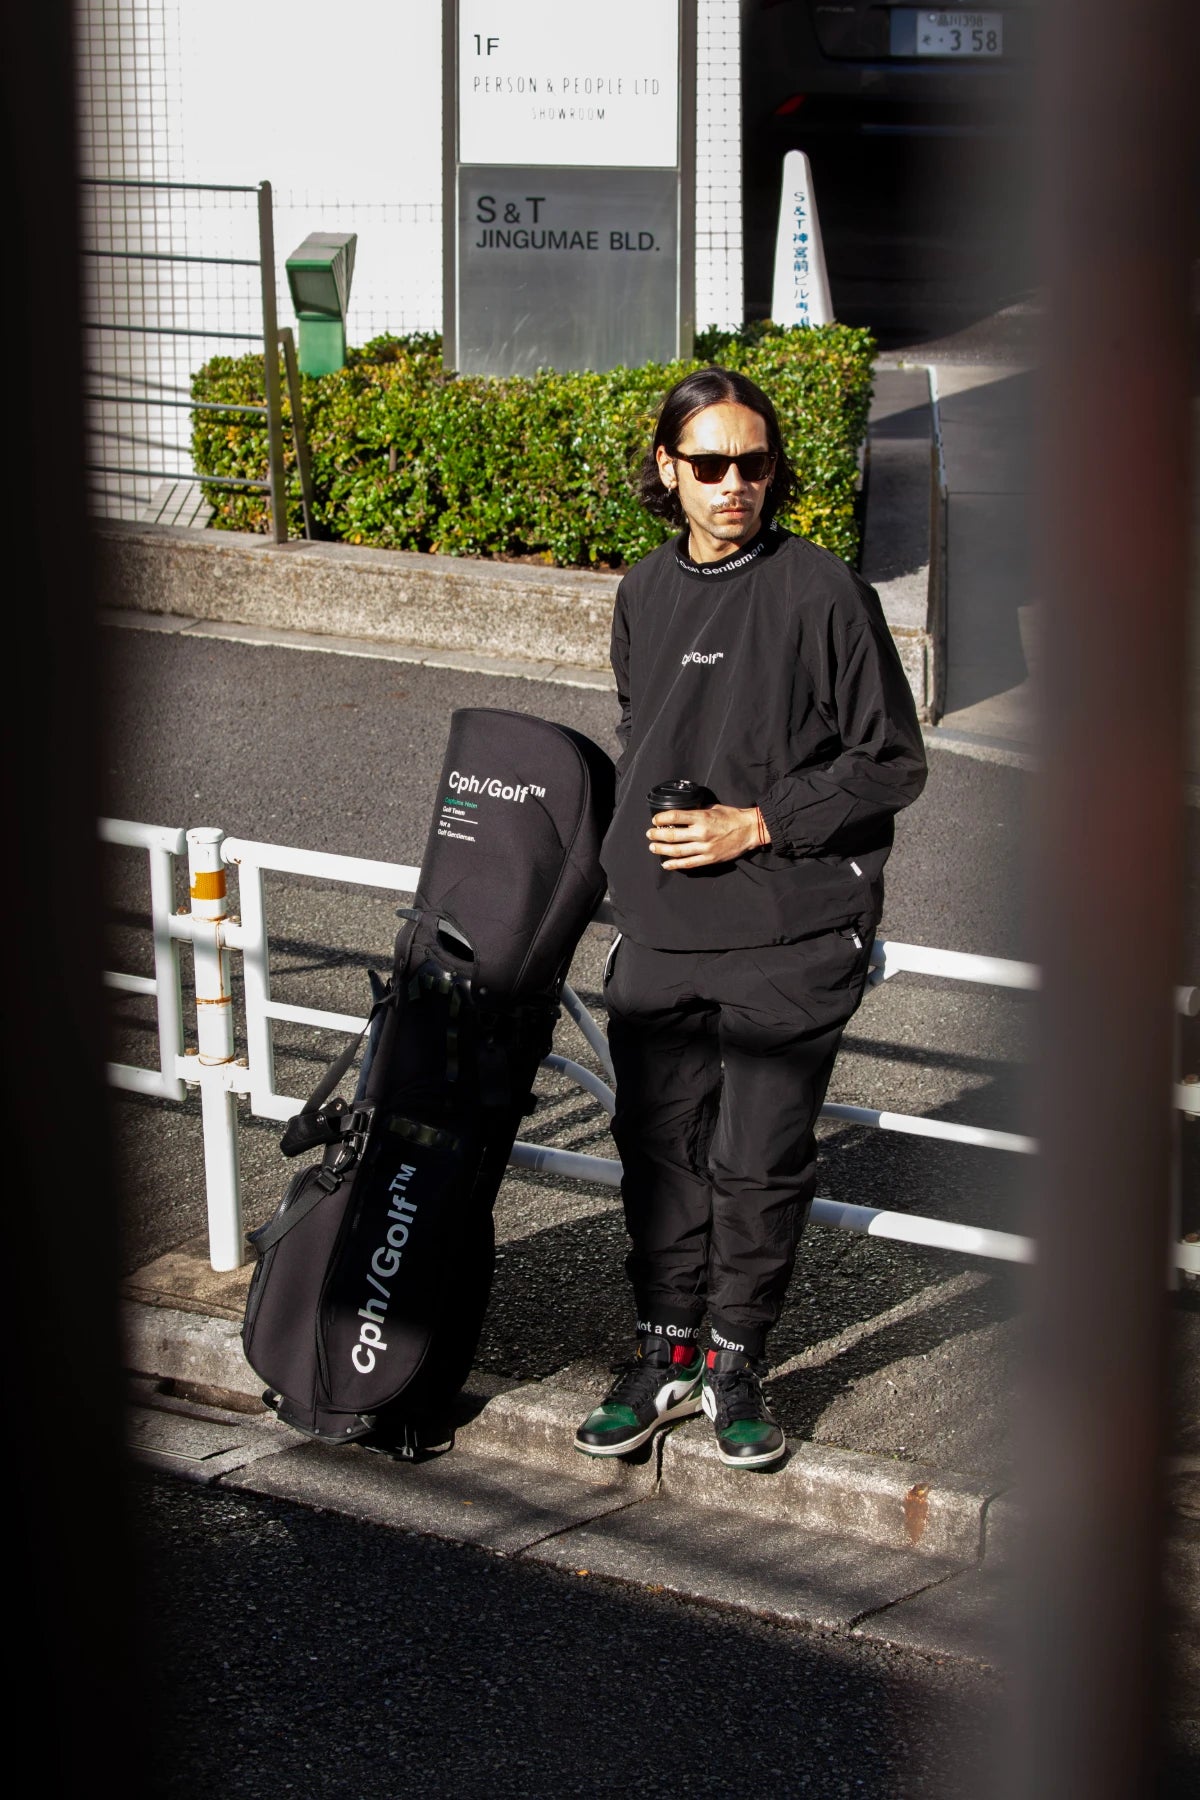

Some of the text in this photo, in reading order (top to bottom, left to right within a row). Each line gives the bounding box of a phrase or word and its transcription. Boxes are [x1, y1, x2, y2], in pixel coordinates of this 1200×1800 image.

[474, 34, 500, 56] 1F
[473, 76, 660, 96] PERSON & PEOPLE LTD
[531, 106, 606, 121] SHOWROOM
[476, 229, 661, 251] JINGUMAE BLD.
[701, 542, 765, 575] Gentleman
[654, 1324, 663, 1335] a
[666, 1324, 693, 1339] Golf
